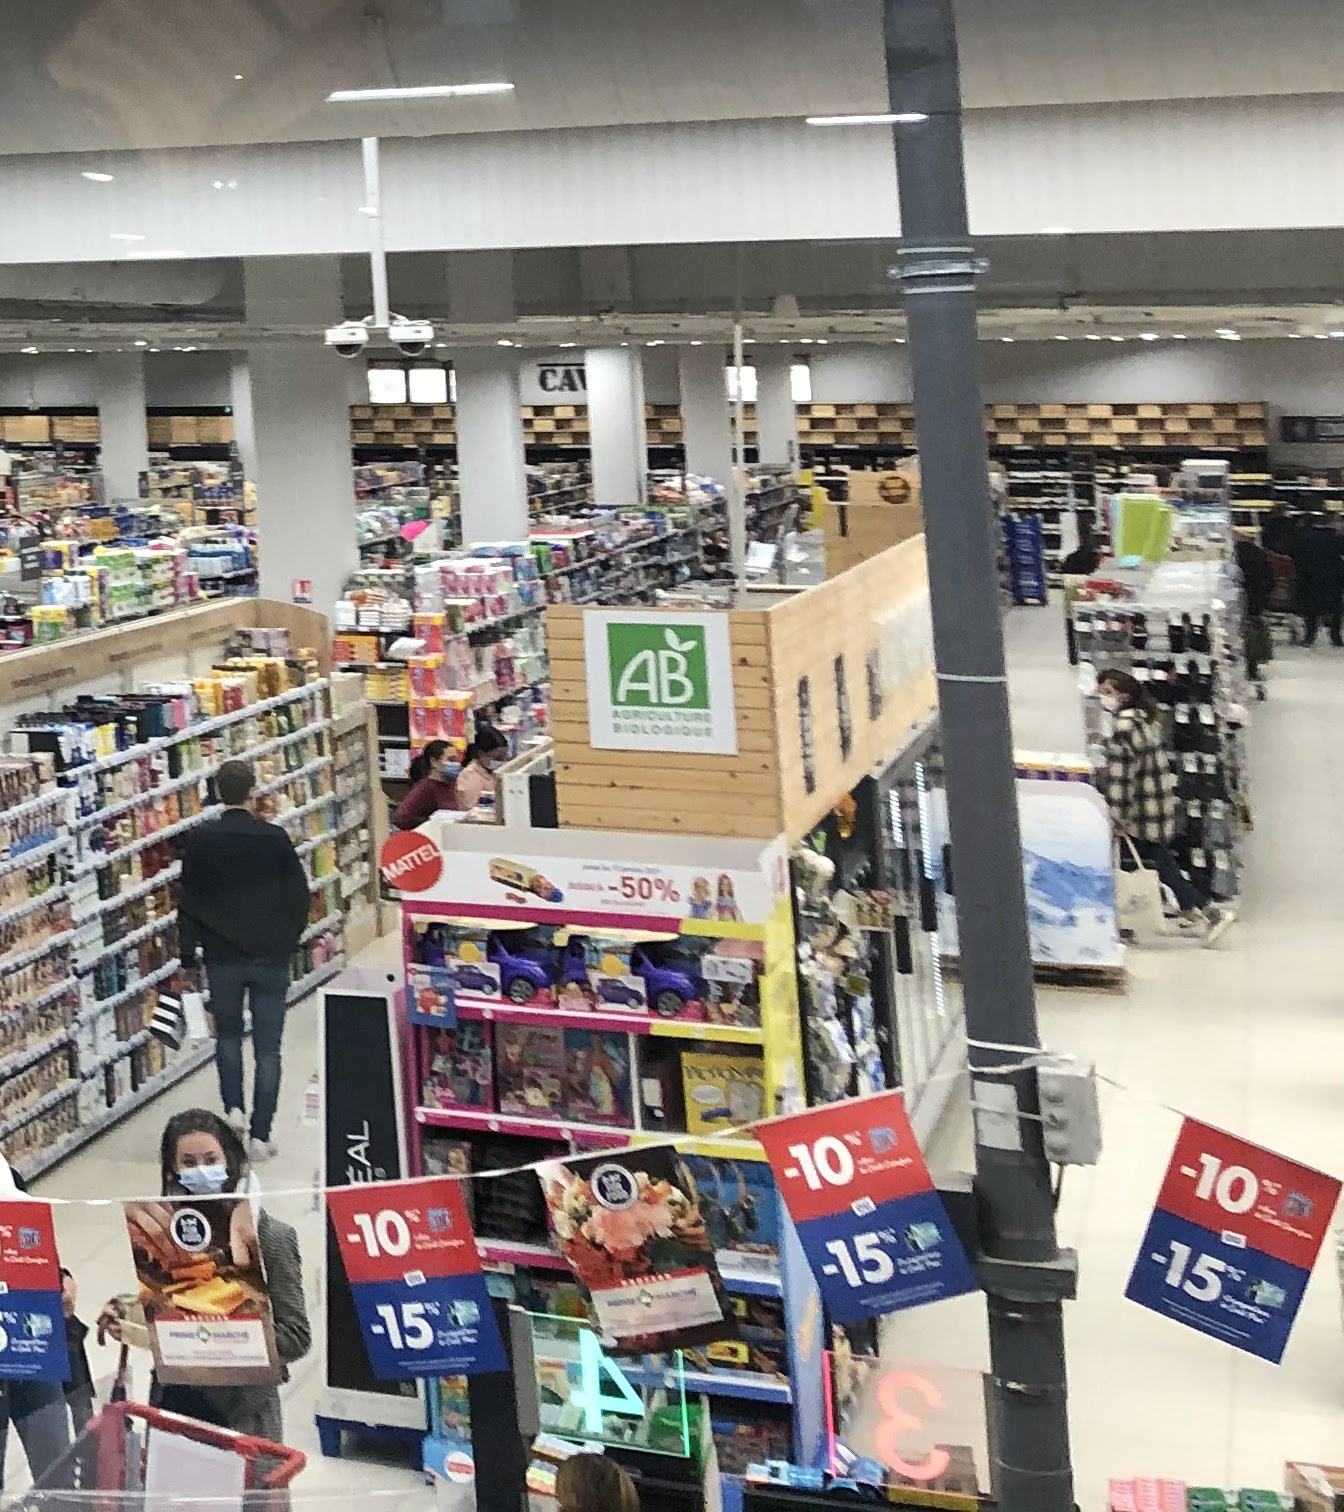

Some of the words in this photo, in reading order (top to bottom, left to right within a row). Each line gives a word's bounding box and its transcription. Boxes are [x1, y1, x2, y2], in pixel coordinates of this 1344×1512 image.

[616, 649, 694, 704] AB
[612, 710, 712, 723] AGRICULTURE
[613, 723, 712, 737] BIOLOGIQUE
[381, 844, 440, 880] MATTEL
[608, 875, 681, 903] -50%
